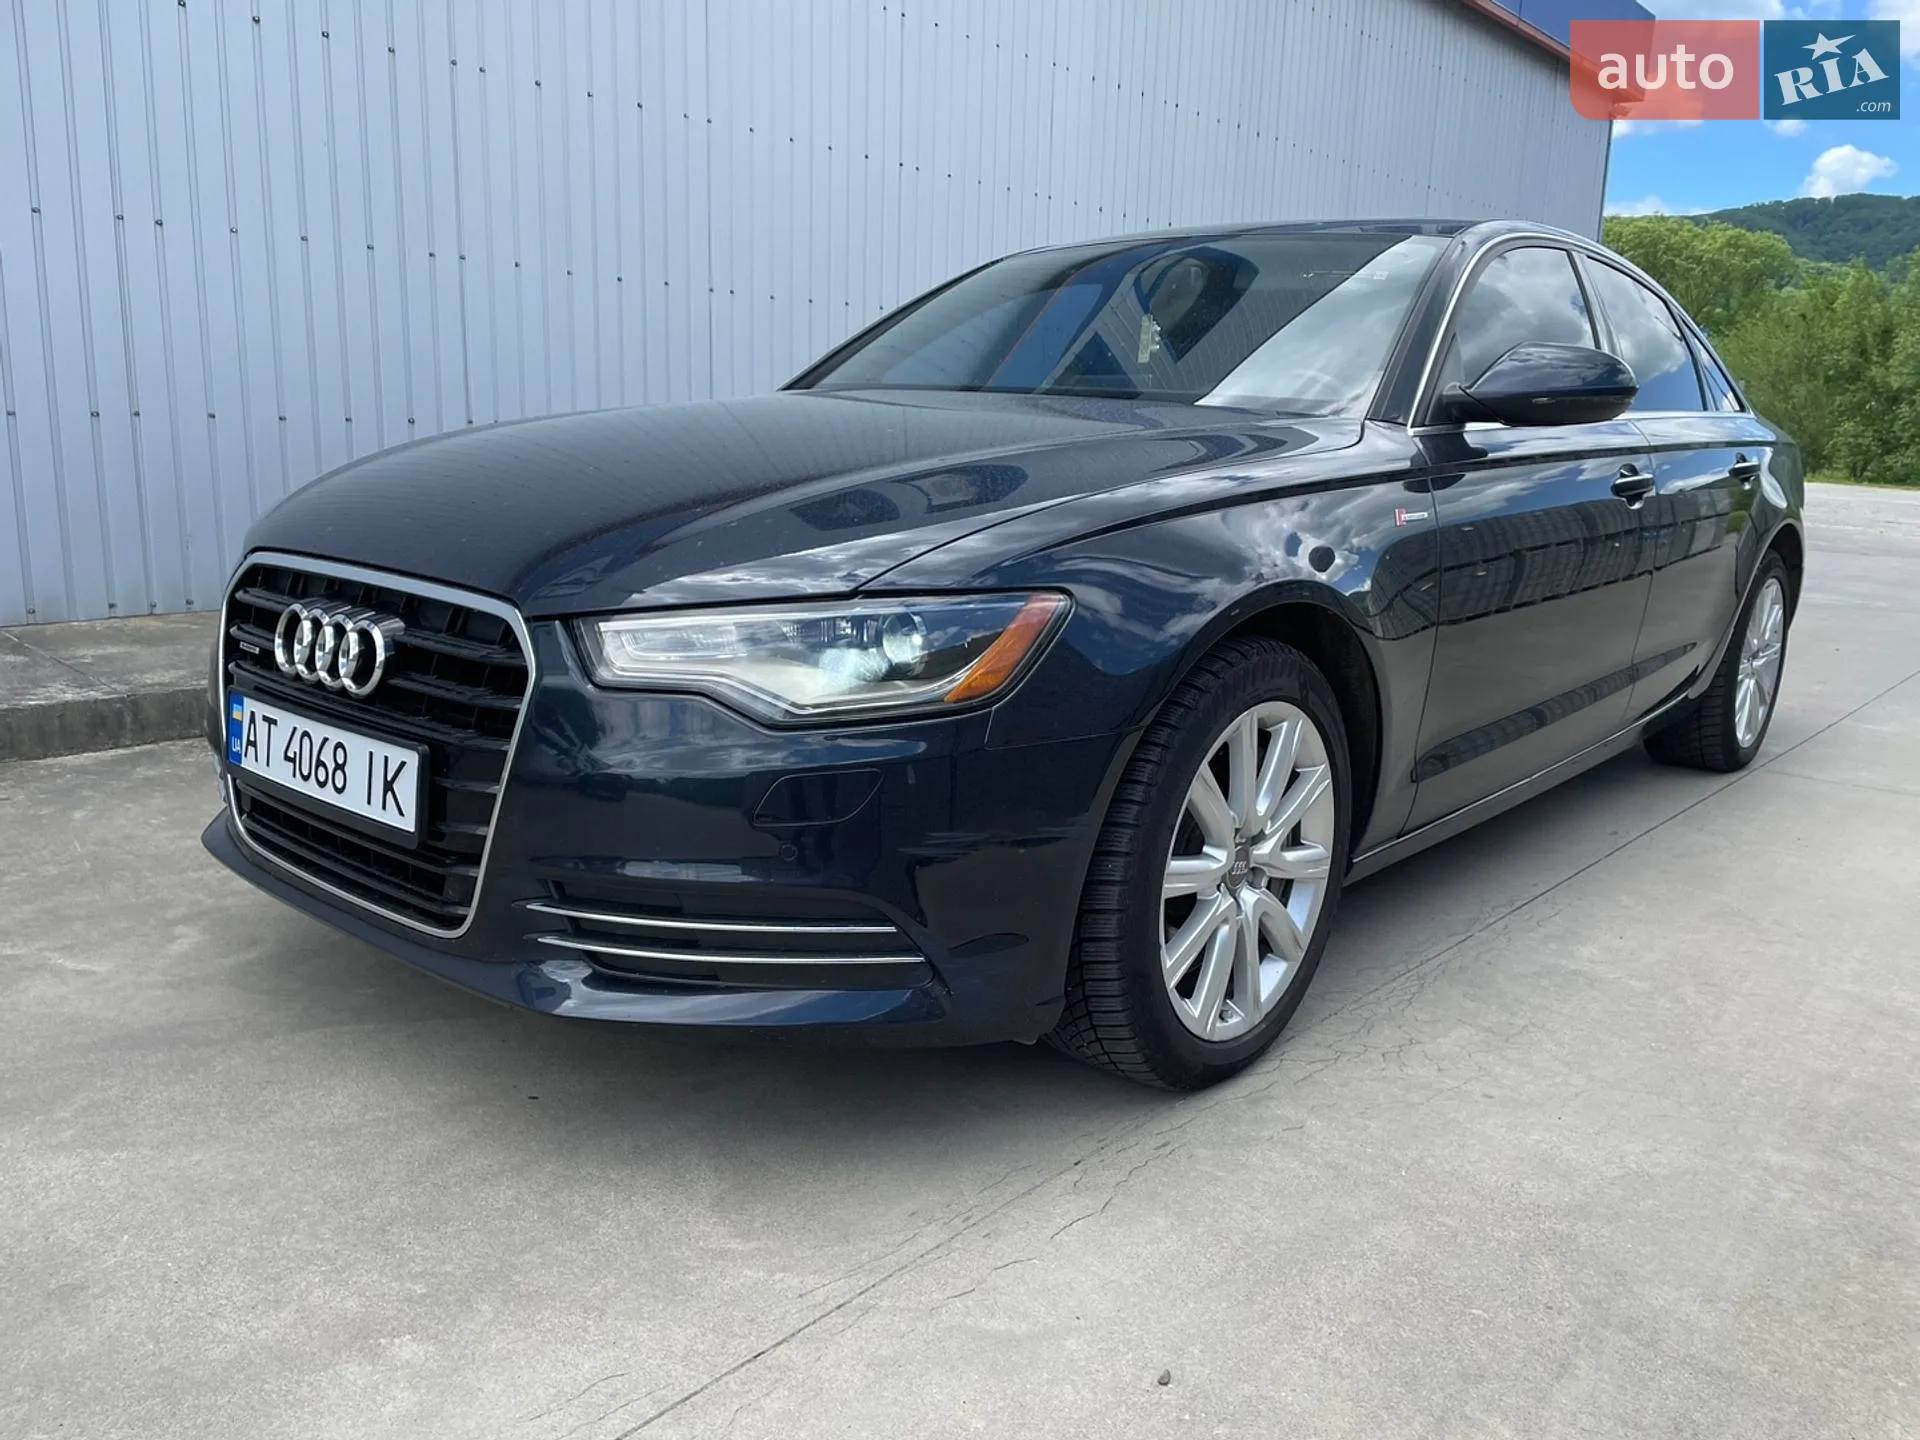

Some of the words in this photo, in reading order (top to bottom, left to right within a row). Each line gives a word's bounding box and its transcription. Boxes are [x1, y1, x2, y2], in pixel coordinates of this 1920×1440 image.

[231, 735, 242, 755] UA
[244, 710, 278, 768] AT
[284, 726, 347, 795] 4068
[366, 750, 407, 818] IK
